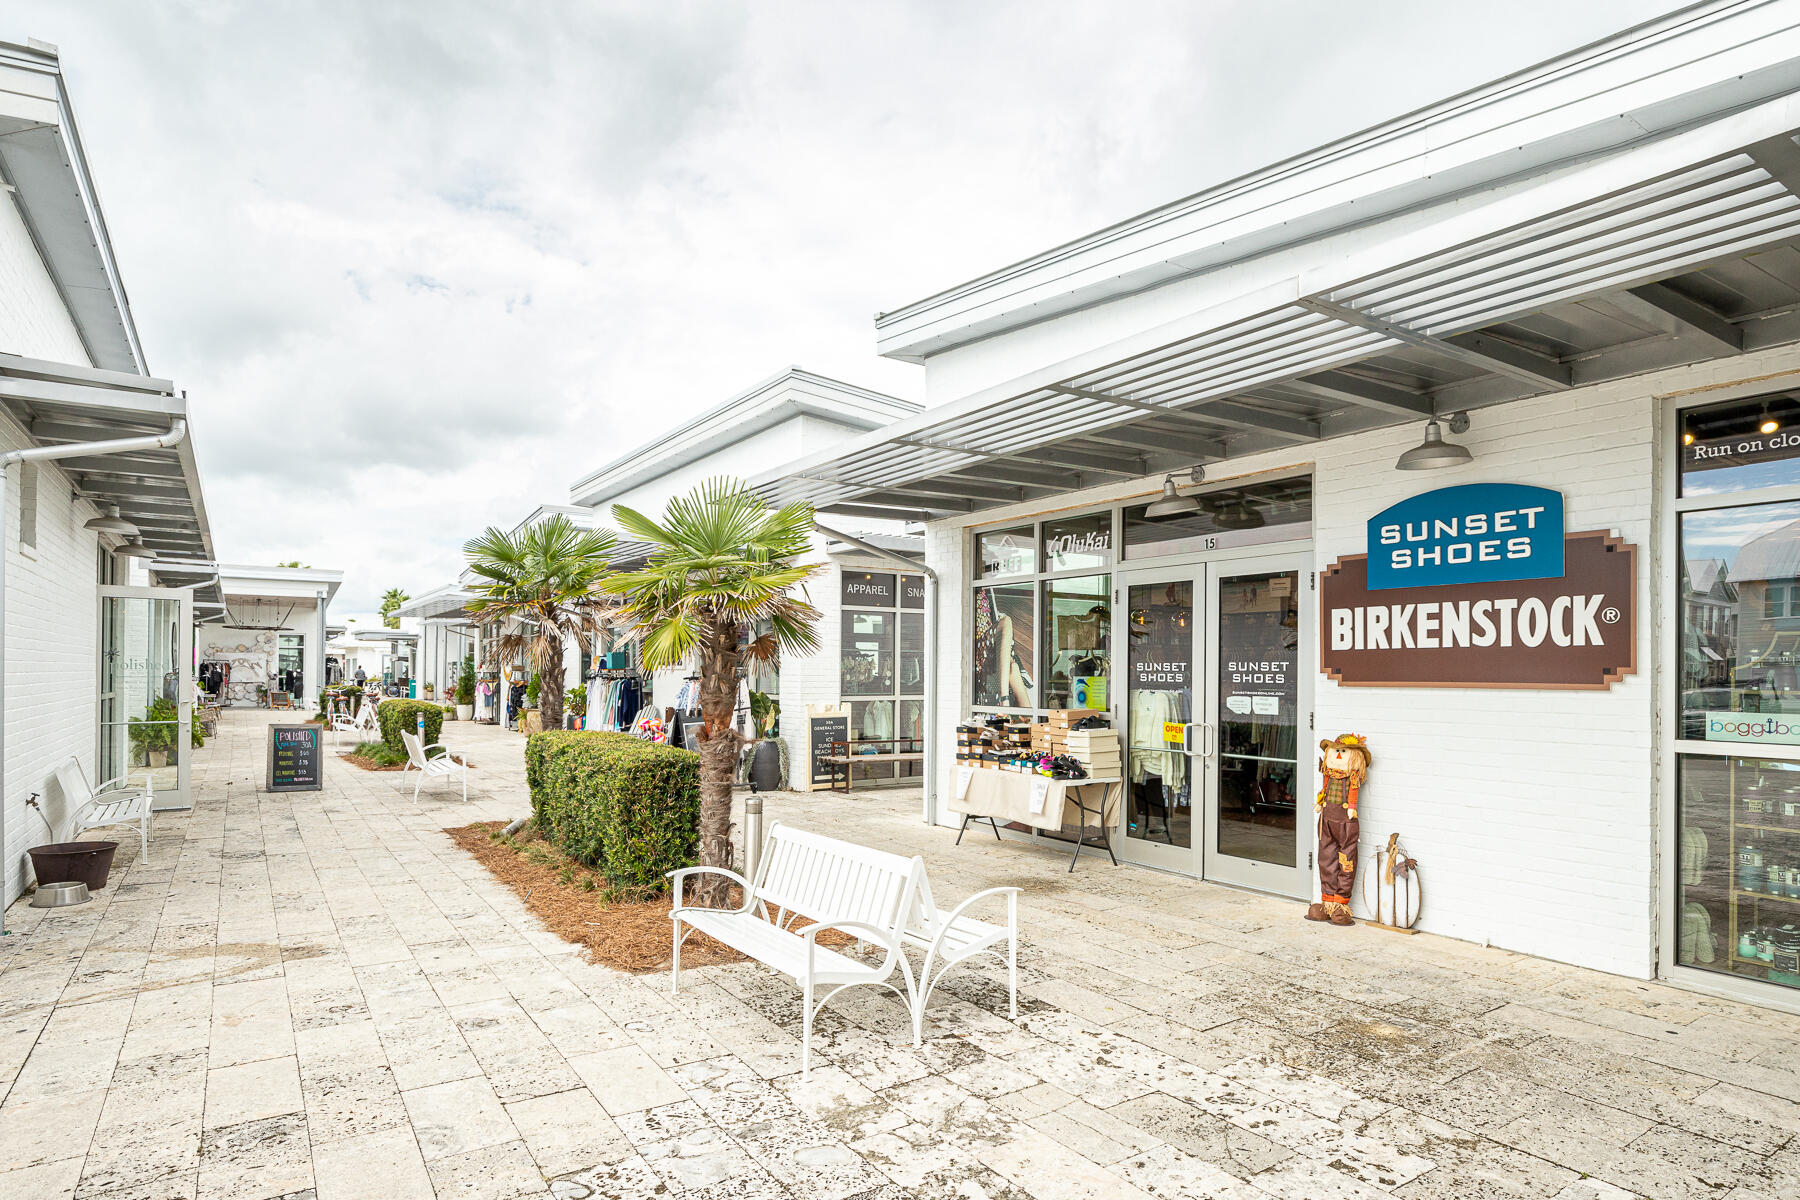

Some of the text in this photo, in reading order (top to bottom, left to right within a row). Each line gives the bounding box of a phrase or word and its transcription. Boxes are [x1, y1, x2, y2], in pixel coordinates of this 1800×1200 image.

[1693, 433, 1800, 460] Run on clo
[1380, 506, 1544, 545] SUNSET
[1061, 530, 1109, 554] OluKai
[1204, 537, 1215, 549] 15
[1391, 536, 1532, 569] SHOES
[847, 583, 889, 596] APPAREL
[1136, 662, 1187, 671] SUNSET
[1228, 661, 1290, 672] SUNSET
[1139, 673, 1184, 682] SHOES
[1232, 673, 1285, 684] SHOES
[1165, 725, 1184, 734] OPEN
